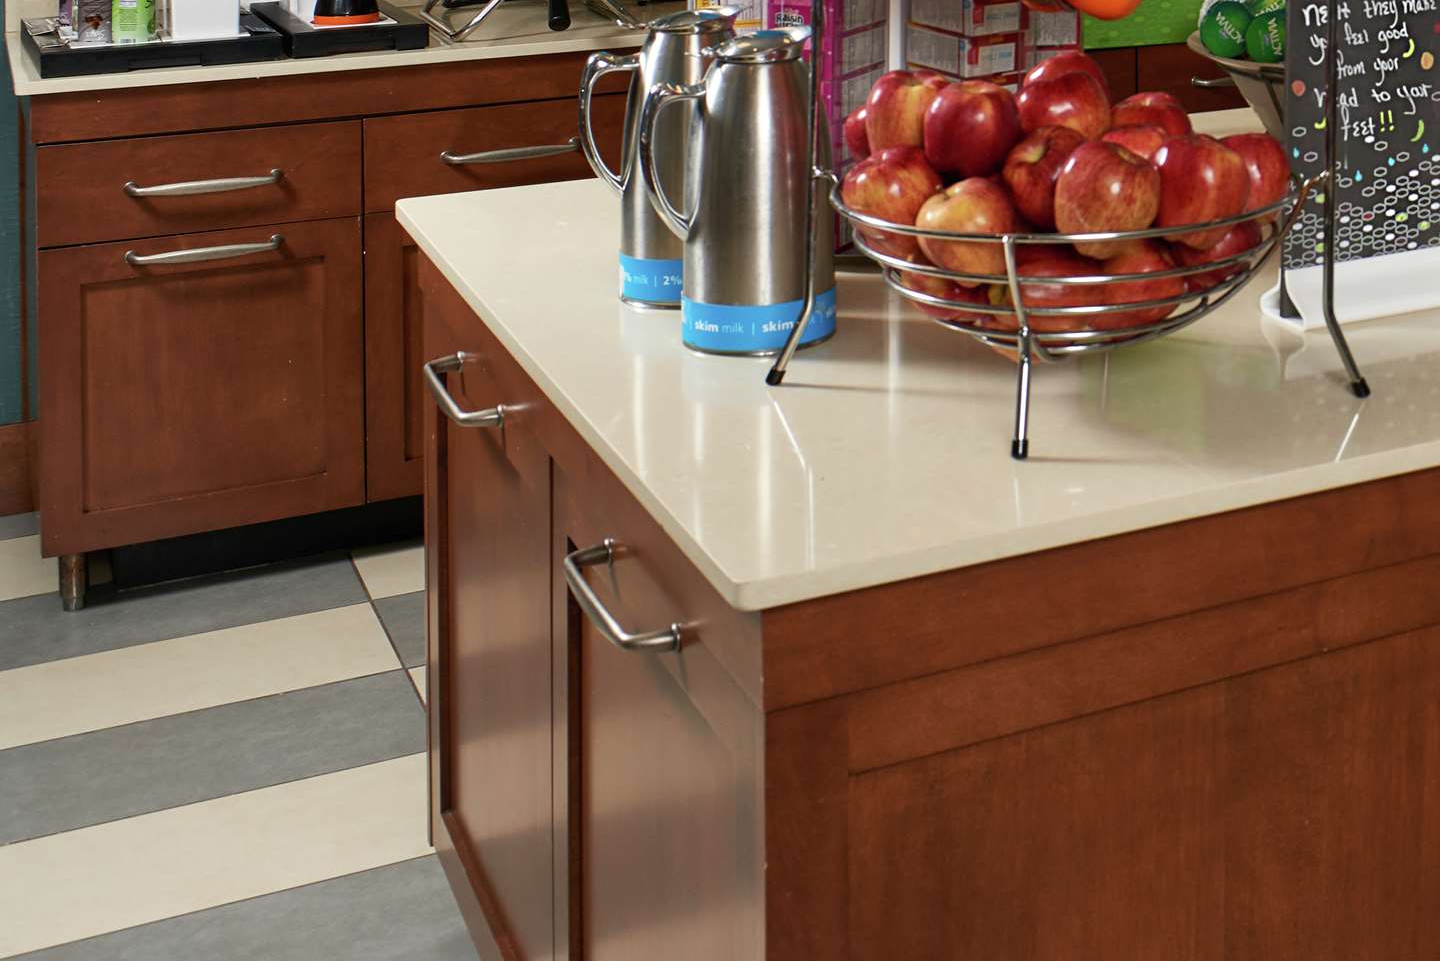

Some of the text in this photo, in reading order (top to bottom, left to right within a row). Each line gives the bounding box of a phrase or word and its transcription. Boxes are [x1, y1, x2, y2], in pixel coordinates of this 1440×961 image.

[1215, 10, 1243, 44] ACTIVIA
[1377, 21, 1409, 54] good
[1373, 57, 1400, 87] your
[1370, 88, 1391, 103] to
[663, 275, 682, 286] 2%
[694, 319, 795, 334] skim milk skim
